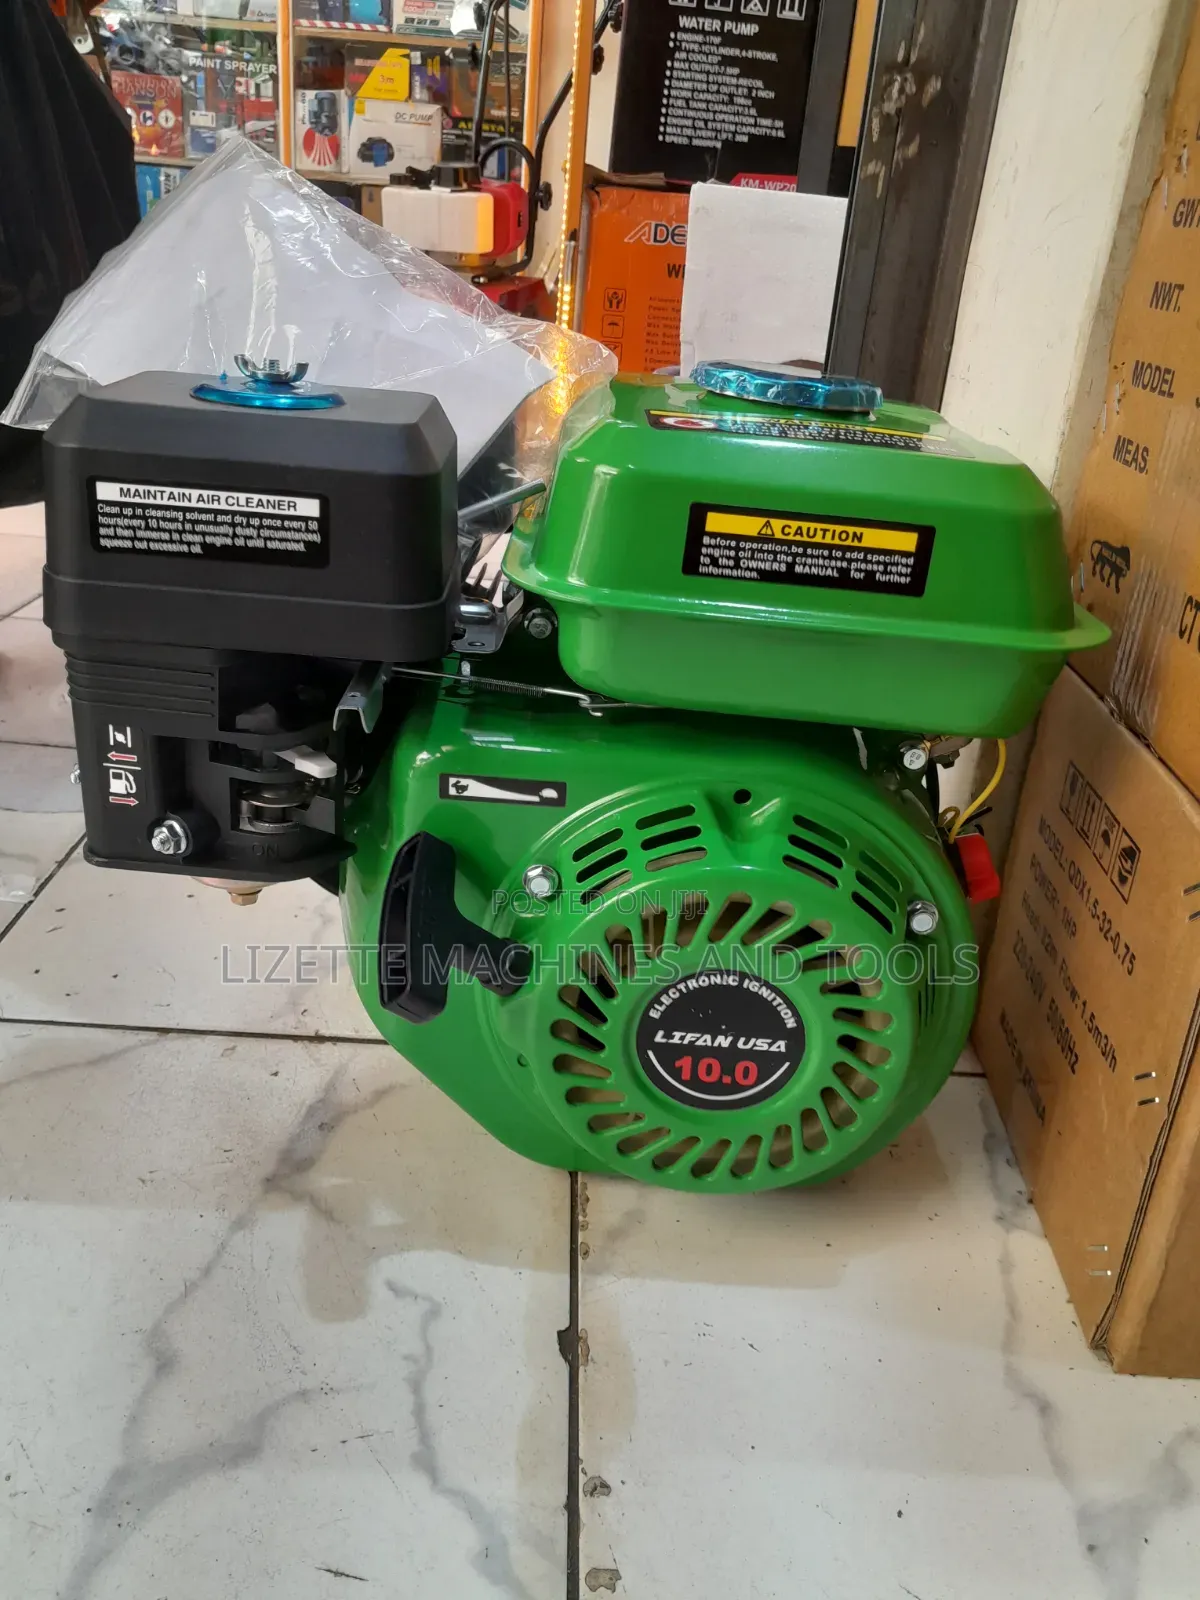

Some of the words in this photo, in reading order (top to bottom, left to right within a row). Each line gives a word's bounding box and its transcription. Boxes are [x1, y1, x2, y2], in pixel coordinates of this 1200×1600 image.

[679, 15, 721, 32] WATER
[724, 20, 759, 36] PUMP
[188, 56, 222, 69] PAINT
[224, 60, 277, 74] SPRAYER
[673, 60, 690, 70] MAX
[674, 50, 687, 60] AIR
[672, 70, 708, 82] STARTING
[670, 88, 692, 99] WORK
[671, 79, 708, 91] DIAMETER
[708, 83, 719, 92] OF
[752, 88, 757, 97] 2
[757, 89, 775, 99] INCH
[669, 97, 687, 108] FUEL
[689, 100, 707, 110] TANK
[394, 111, 408, 120] DC
[410, 113, 434, 122] PUMP
[667, 116, 693, 127] ENGINE
[694, 119, 706, 129] OIL
[707, 121, 736, 132] SYSTEM
[668, 107, 714, 120] CONTINUOUS
[715, 112, 755, 125] OPERATION
[741, 176, 797, 192] KM-WP20
[667, 263, 686, 279] W
[1149, 280, 1184, 313] NWT.
[1131, 359, 1176, 399] MODEL
[1112, 434, 1150, 476] MEAS.
[119, 487, 192, 503] MAINTAIN
[196, 493, 221, 505] AIR
[225, 495, 298, 512] CLEANER
[97, 503, 120, 514] Clean
[122, 507, 133, 517] up
[135, 506, 143, 516] in
[145, 508, 183, 521] cleansing
[185, 511, 215, 521] solvent
[216, 513, 232, 523] and
[234, 514, 248, 526] dry
[249, 517, 260, 527] up
[262, 518, 282, 527] once
[284, 519, 306, 531] every
[307, 520, 318, 531] 50
[98, 514, 146, 530] hours(every
[148, 518, 158, 528] 10
[160, 519, 183, 531] hours
[185, 521, 193, 531] in
[194, 523, 233, 537] unusually
[235, 526, 258, 540] dusty
[260, 527, 321, 544] circumstances)
[99, 526, 115, 537] and
[116, 527, 135, 538] then
[136, 529, 171, 540] immerse
[172, 531, 180, 540] in
[182, 532, 204, 543] clean
[205, 534, 233, 548] engine
[234, 536, 246, 547] oil
[246, 537, 265, 548] until
[781, 524, 864, 543] CAUTION
[134, 540, 149, 550] out
[149, 541, 189, 554] excessive
[703, 535, 737, 547] Before
[807, 548, 829, 557] sure
[832, 549, 842, 558] to
[845, 551, 864, 560] add
[867, 553, 914, 566] specified
[700, 555, 711, 565] to
[718, 557, 734, 567] the
[740, 559, 786, 572] OWNERS
[795, 564, 839, 578] MANUAL
[850, 570, 865, 580] for
[876, 571, 911, 584] further
[701, 546, 736, 558] engine
[738, 550, 751, 558] oil
[754, 551, 774, 560] into
[777, 554, 793, 563] the
[887, 564, 912, 574] refer
[1061, 906, 1077, 940] 1HP
[1068, 860, 1136, 976] QDX1.5-32-0.75
[649, 974, 739, 1019] ELECTRONIC
[743, 978, 797, 1029] IGNITION
[653, 1030, 733, 1048] LIFAN
[736, 1037, 788, 1052] USA
[674, 1055, 758, 1086] 10.0
